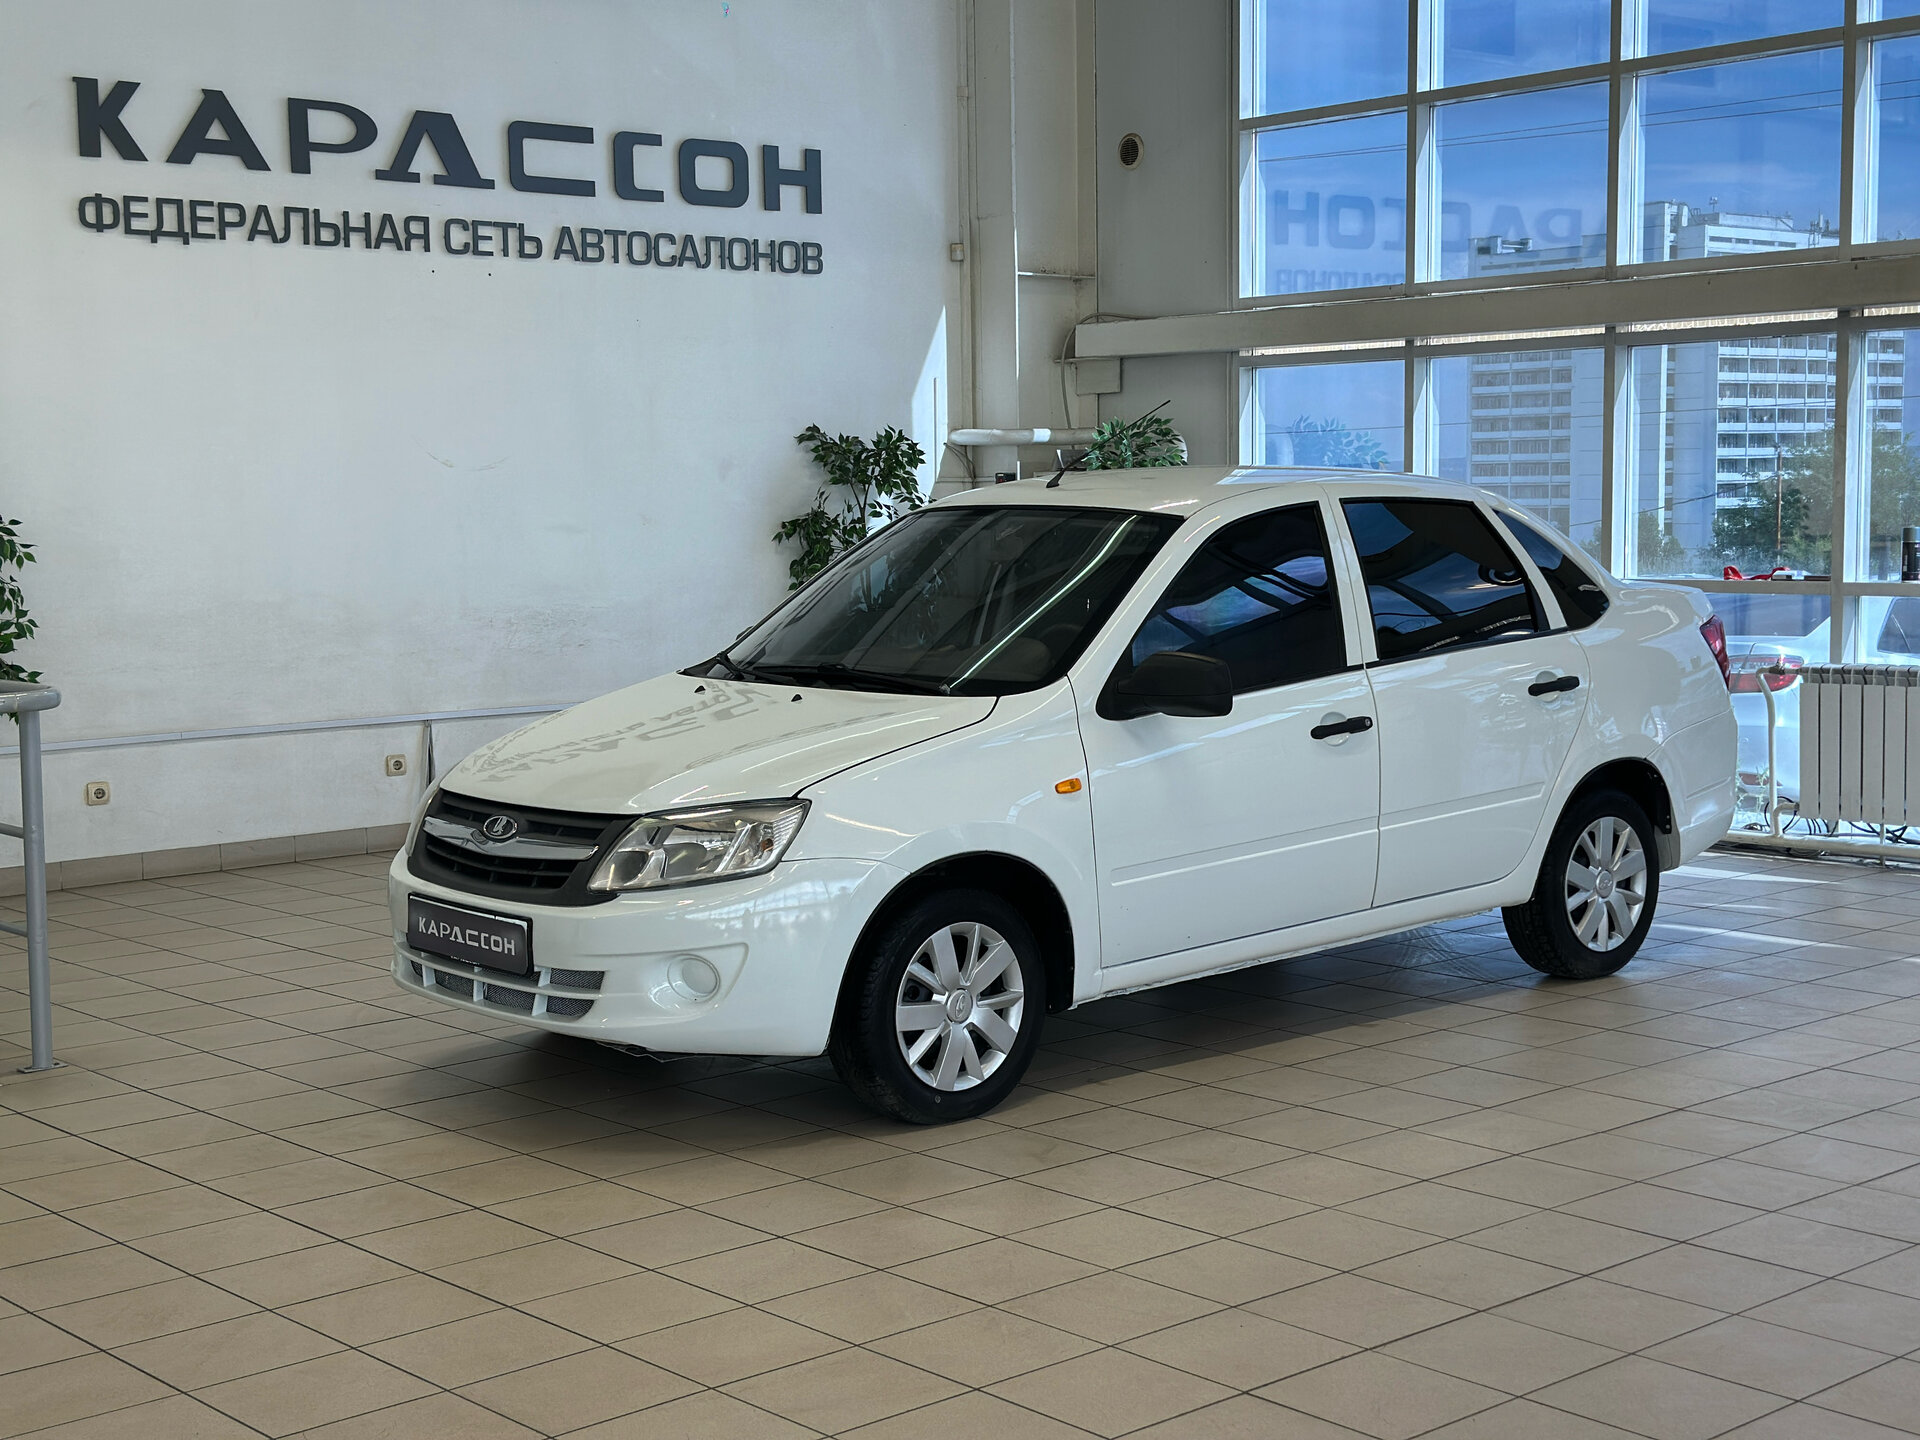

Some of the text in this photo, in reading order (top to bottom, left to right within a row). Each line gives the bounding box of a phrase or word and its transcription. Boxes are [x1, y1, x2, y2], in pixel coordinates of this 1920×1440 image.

[72, 77, 823, 214] КАРАССОН
[78, 193, 824, 275] ФЕДЕРАЛЬНАЯ СЕТЬ АВТОСАЛОНОВ
[419, 917, 515, 956] КАРАССОН
